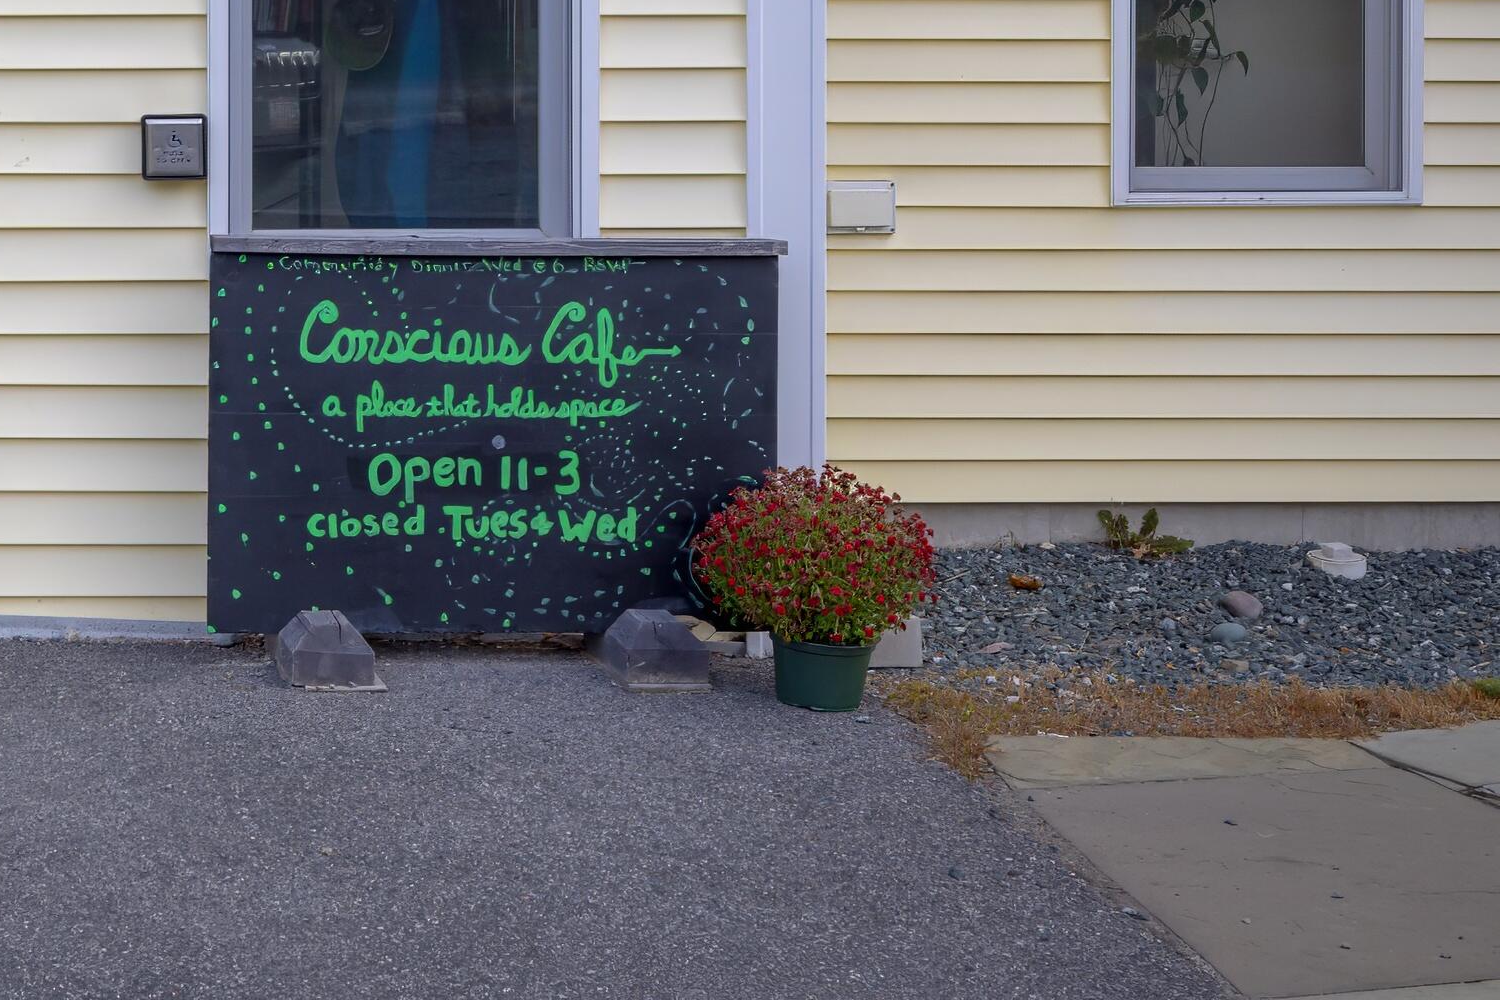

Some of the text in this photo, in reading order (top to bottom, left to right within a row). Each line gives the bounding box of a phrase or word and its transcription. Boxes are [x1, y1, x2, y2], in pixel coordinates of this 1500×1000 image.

[300, 300, 640, 388] Conscious Cafe
[322, 380, 643, 432] a place that holds space
[368, 450, 581, 504] Open 11-3
[306, 504, 425, 538] closed
[442, 505, 528, 540] Tues
[558, 507, 637, 542] Wed
